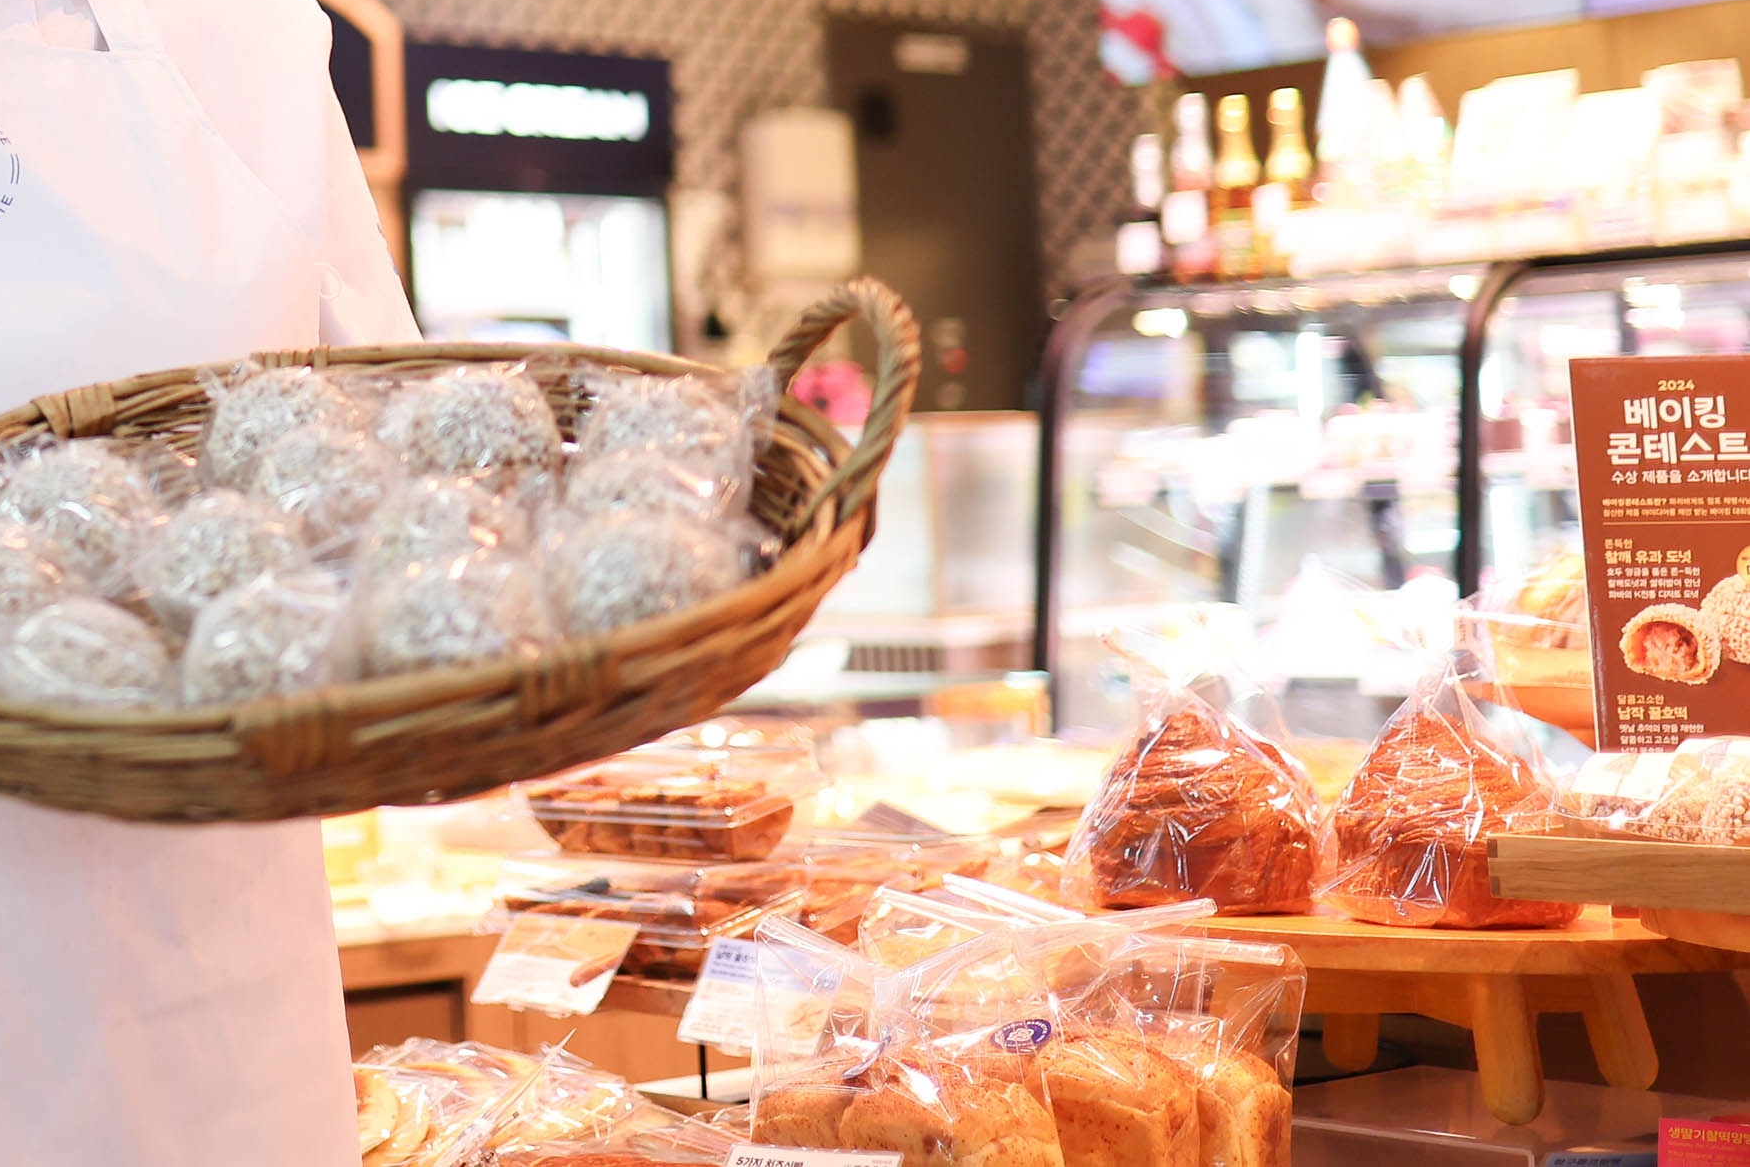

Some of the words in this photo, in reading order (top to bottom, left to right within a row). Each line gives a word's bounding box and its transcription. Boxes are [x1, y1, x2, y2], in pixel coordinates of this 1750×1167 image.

[1658, 379, 1696, 392] 2024
[1623, 395, 1726, 430] 베이킹
[1607, 431, 1750, 465] 콘테스트
[1611, 470, 1638, 485] 수상
[1642, 469, 1683, 484] 제품을
[1687, 468, 1750, 484] 소개합니다
[1635, 550, 1663, 564] 유과
[1665, 549, 1692, 564] 도넛
[1617, 694, 1665, 705] 달콤고소한
[1617, 705, 1645, 721] 납작
[1648, 705, 1689, 721] 꿀호떡
[1654, 735, 1679, 745] 고소한
[736, 1156, 764, 1167] 5가지
